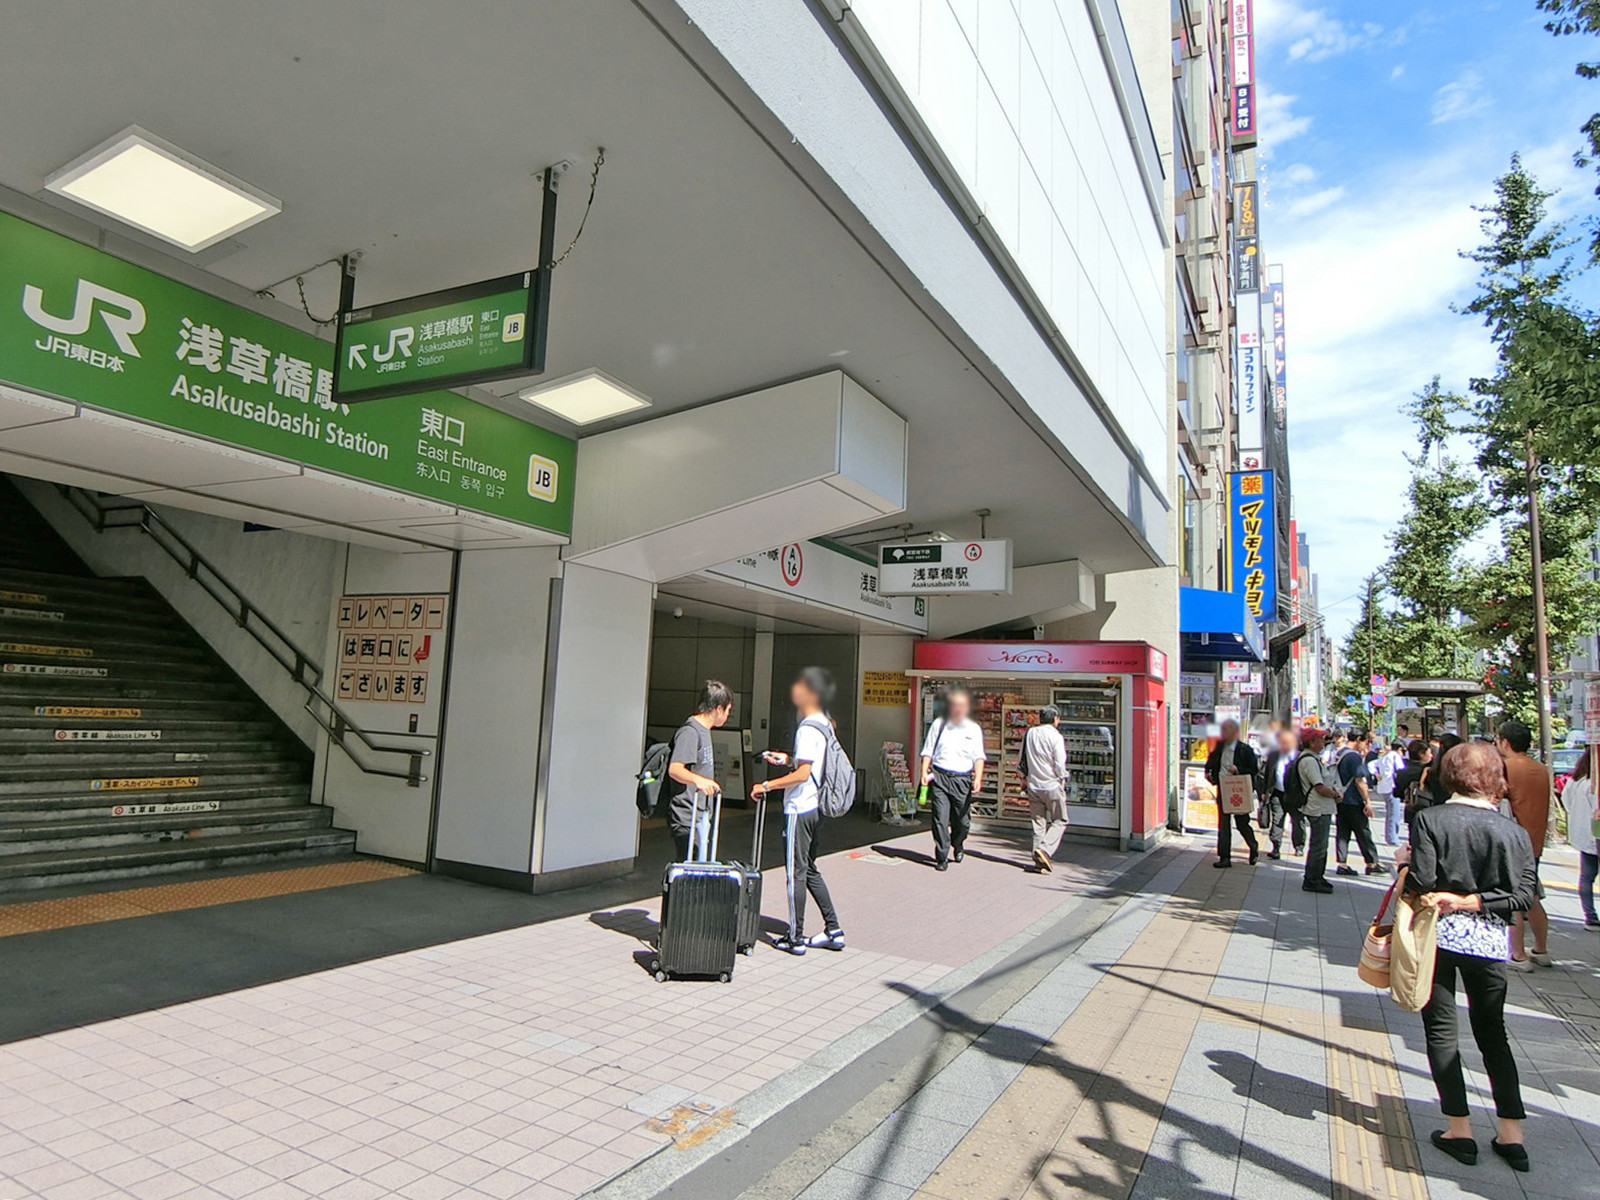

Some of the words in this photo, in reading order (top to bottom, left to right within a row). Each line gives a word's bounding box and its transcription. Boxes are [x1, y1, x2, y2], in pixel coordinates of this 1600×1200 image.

[22, 278, 147, 358] JR
[479, 309, 499, 324] 東口
[418, 314, 474, 342] 浅草橋駅
[507, 321, 520, 335] JB
[35, 335, 126, 373] JR東日本
[372, 326, 415, 364] JR
[416, 335, 474, 354] Asakusabashi
[376, 360, 408, 374] JR東日本
[416, 354, 445, 367] Station
[1244, 347, 1255, 414] ココカラファイン
[170, 374, 320, 440] Asakusabashi
[325, 422, 389, 460] Station
[419, 407, 465, 447] 東口
[417, 439, 449, 463] East
[451, 450, 508, 482] Entrance
[416, 461, 451, 484] 东入口
[535, 469, 551, 488] JB
[485, 482, 505, 499] 입구
[1242, 475, 1262, 494] 薬
[789, 547, 796, 561] A
[787, 561, 798, 577] 16
[913, 567, 969, 581] 浅草橋駅
[340, 602, 441, 621] エレベーター
[344, 638, 410, 657] は西口に
